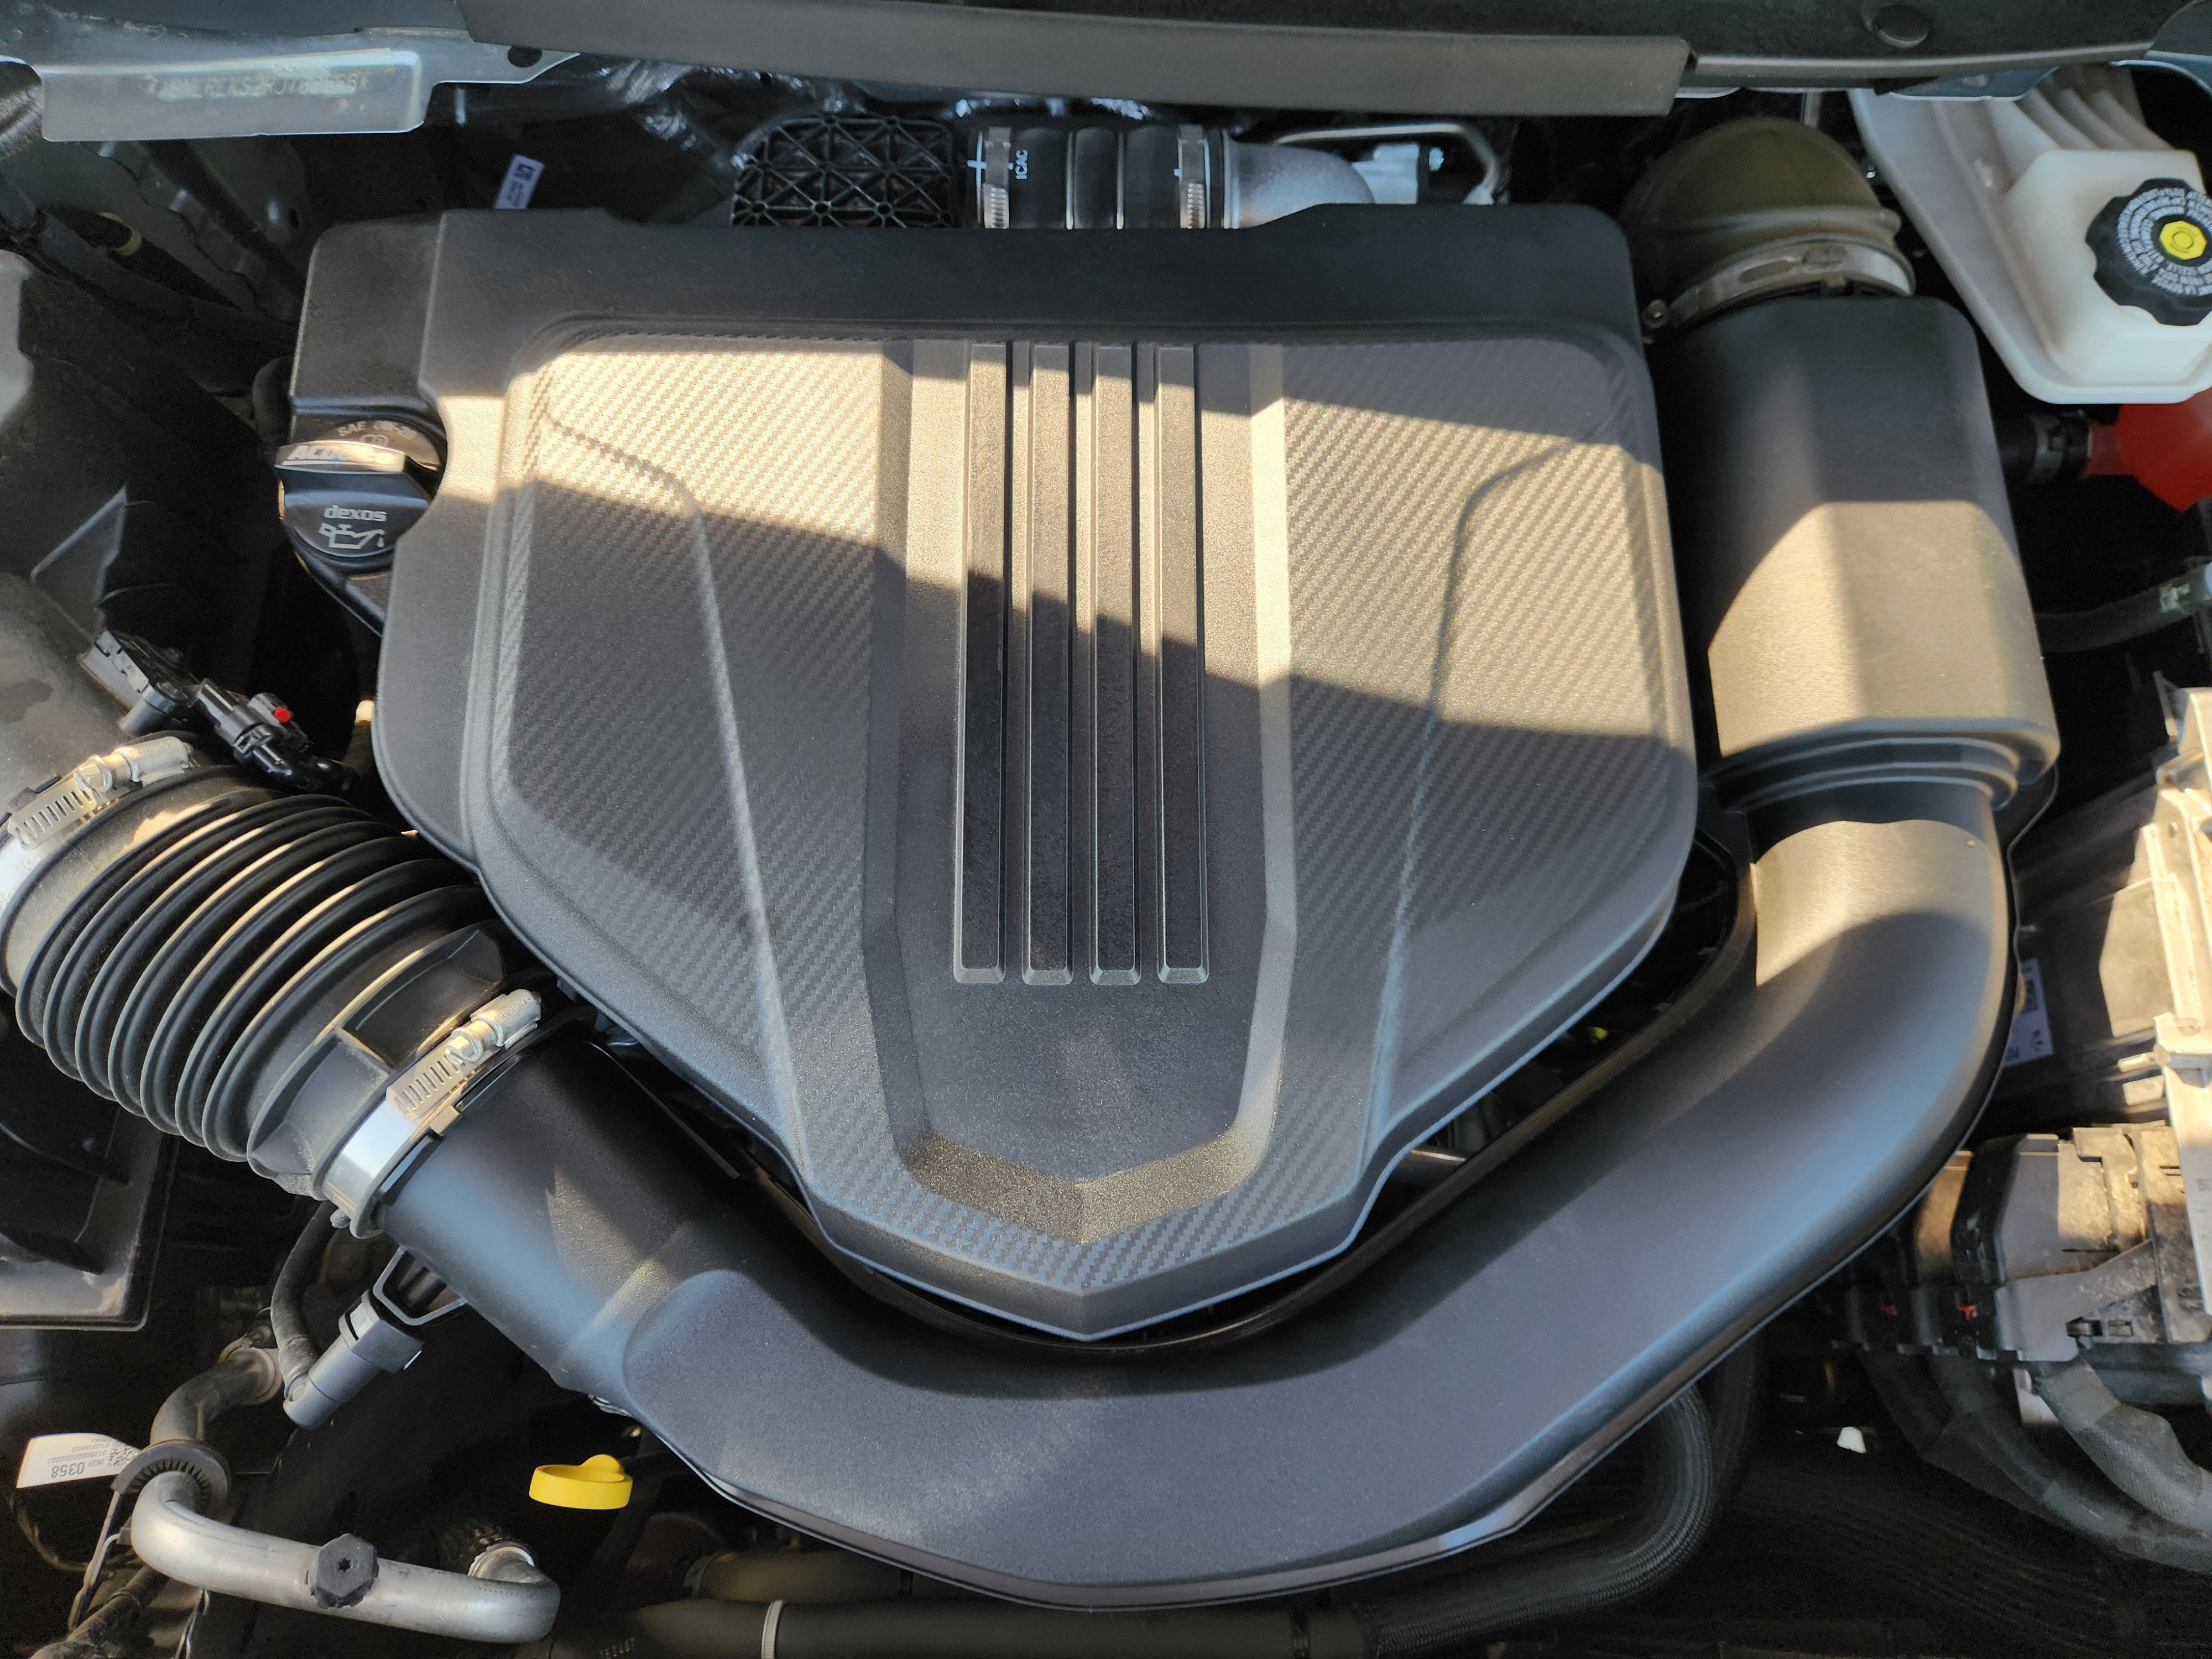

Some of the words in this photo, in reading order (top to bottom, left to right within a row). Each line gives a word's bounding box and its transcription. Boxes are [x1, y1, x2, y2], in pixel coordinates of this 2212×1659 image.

[337, 421, 367, 436] SAE
[286, 445, 395, 465] ACDo
[324, 504, 388, 522] dexos
[50, 1462, 85, 1479] 0358
